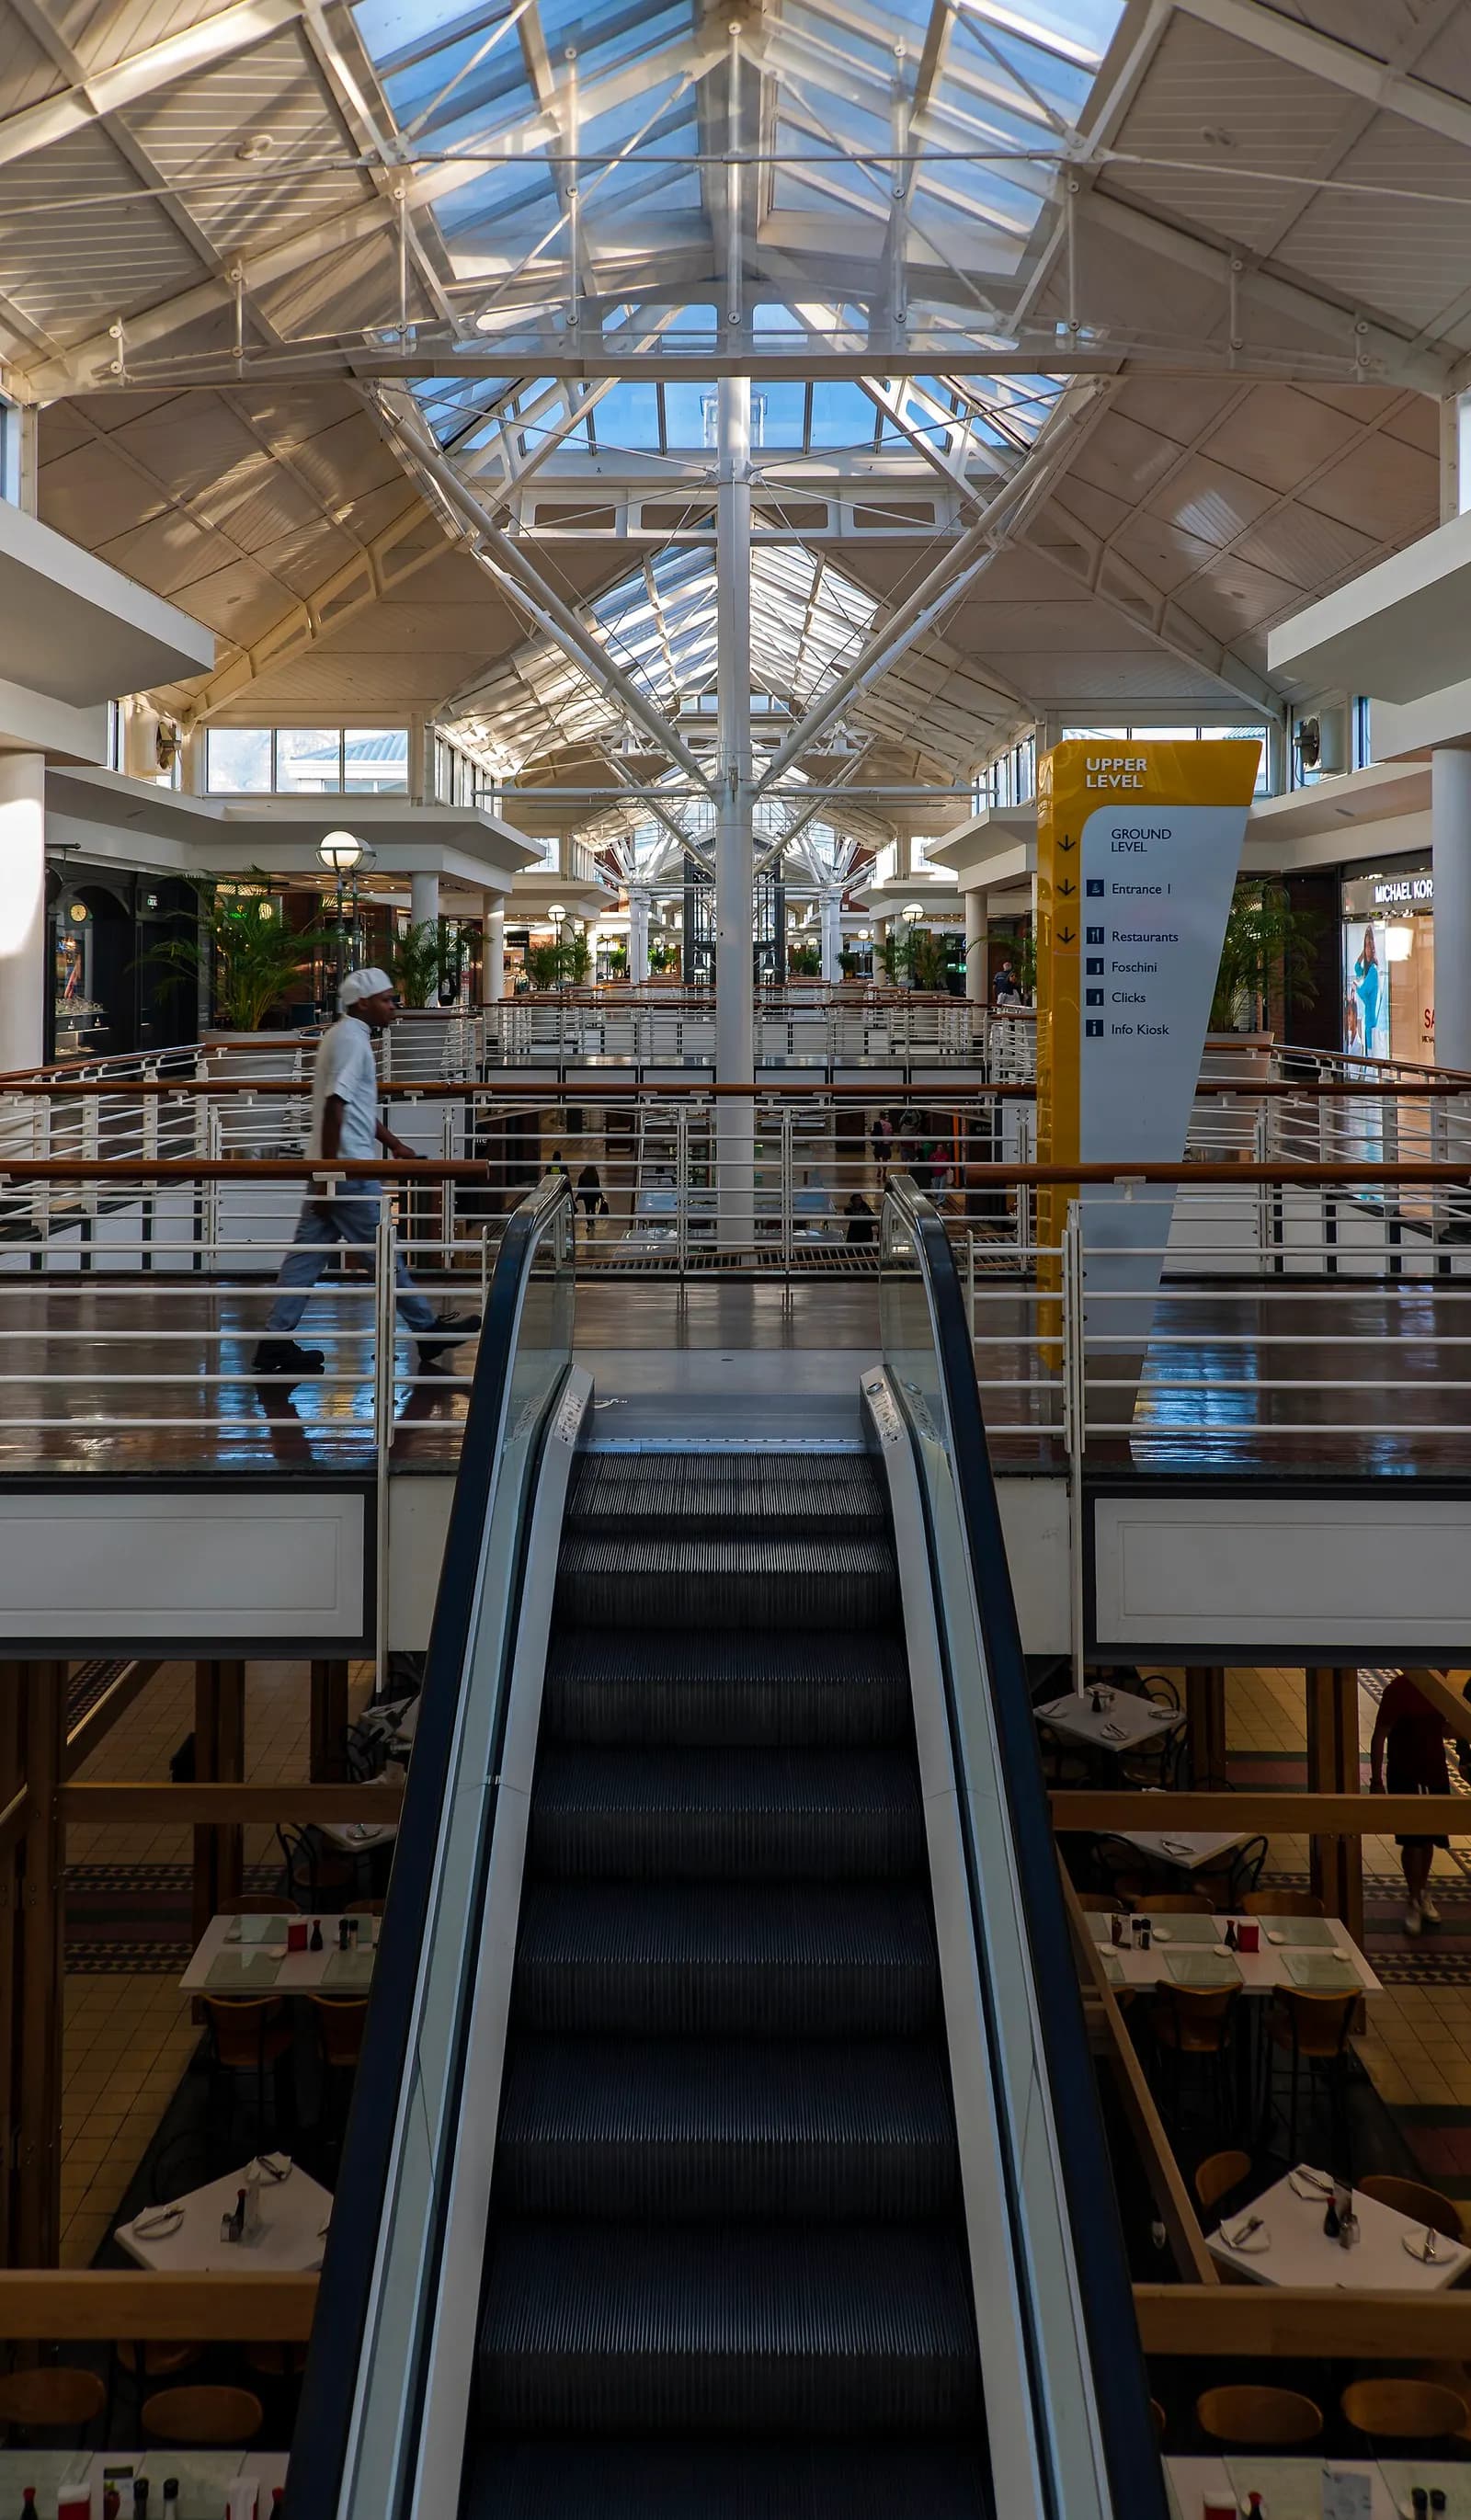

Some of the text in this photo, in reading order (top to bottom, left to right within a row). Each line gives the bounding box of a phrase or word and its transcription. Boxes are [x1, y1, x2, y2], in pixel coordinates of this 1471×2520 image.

[1086, 758, 1147, 771] UPPER
[1086, 774, 1144, 788] LEVEL
[1111, 828, 1172, 839] GROUND
[1111, 841, 1148, 852] LEVEL
[1112, 883, 1162, 895] Entrance
[1374, 879, 1433, 903] MICHAEL KOR
[1112, 930, 1180, 942] Restaurants
[1112, 961, 1157, 973] Foschini
[1112, 992, 1146, 1003] Clicks
[1112, 1023, 1170, 1035] Info Kiosk
